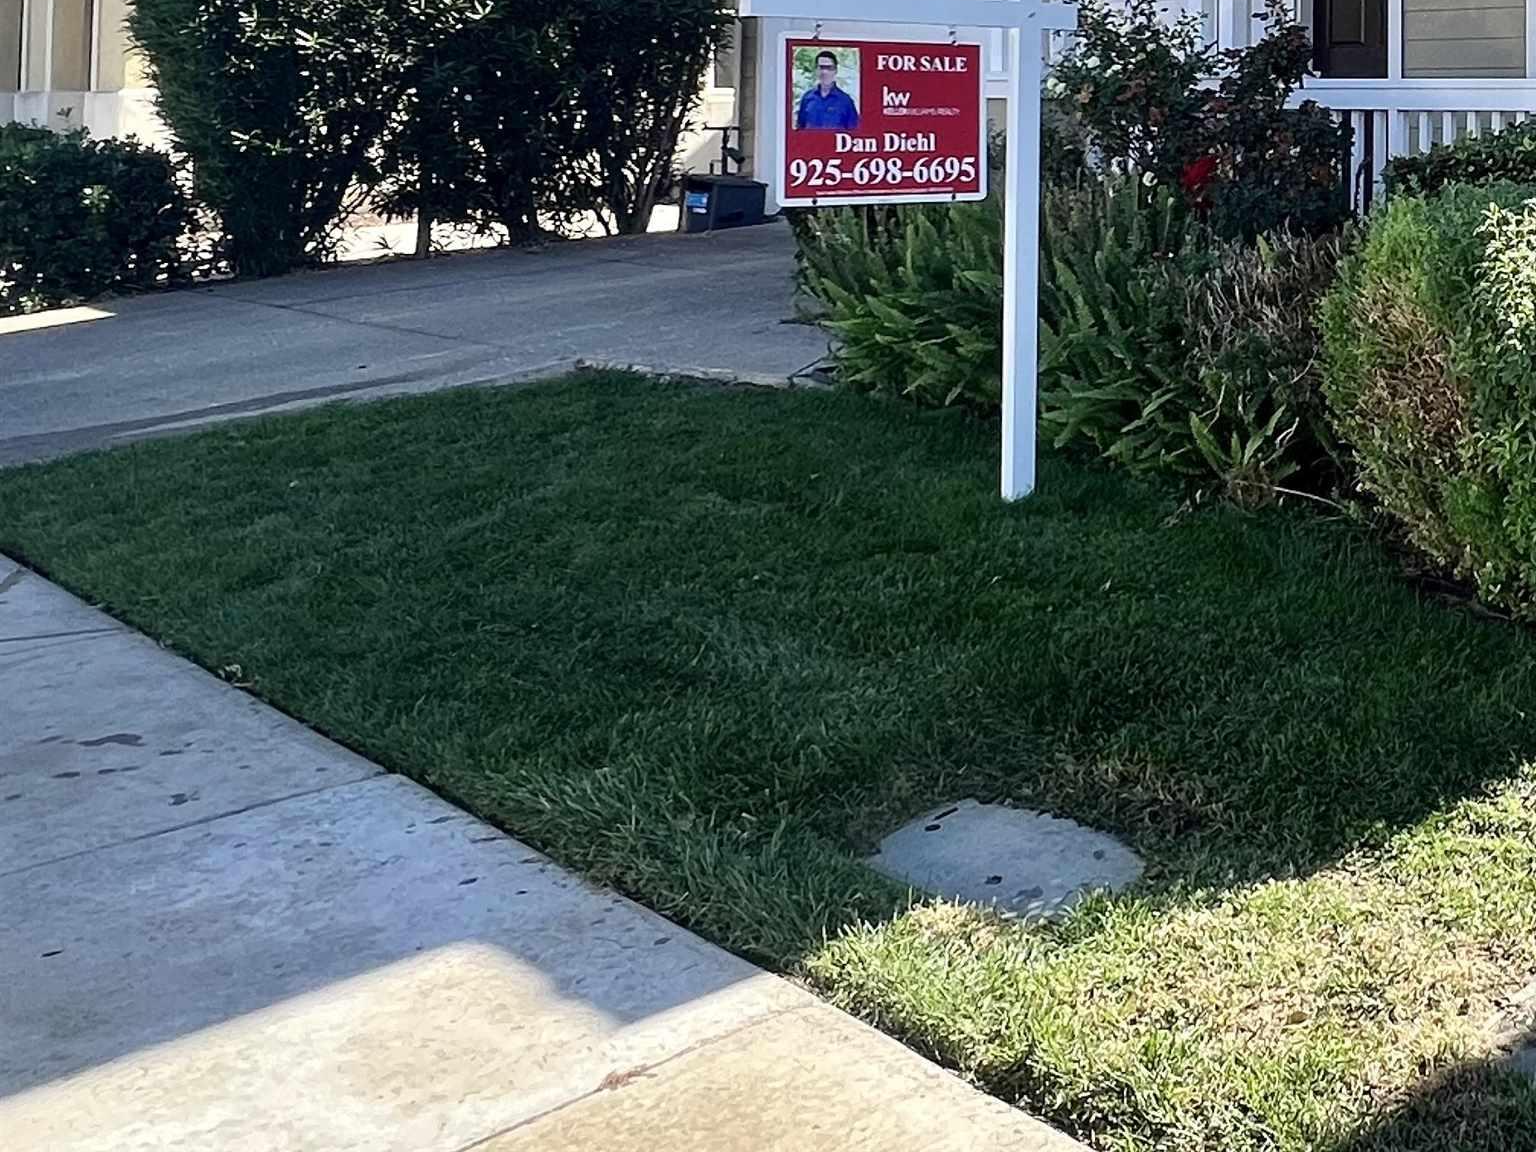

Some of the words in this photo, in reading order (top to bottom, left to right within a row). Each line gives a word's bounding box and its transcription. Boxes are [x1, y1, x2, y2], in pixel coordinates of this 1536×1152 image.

[877, 55, 917, 71] FOR
[919, 56, 968, 72] SALE
[882, 86, 911, 106] kw
[835, 133, 878, 153] Dan
[883, 133, 936, 152] Diehl
[789, 156, 976, 186] 925-698-6695
